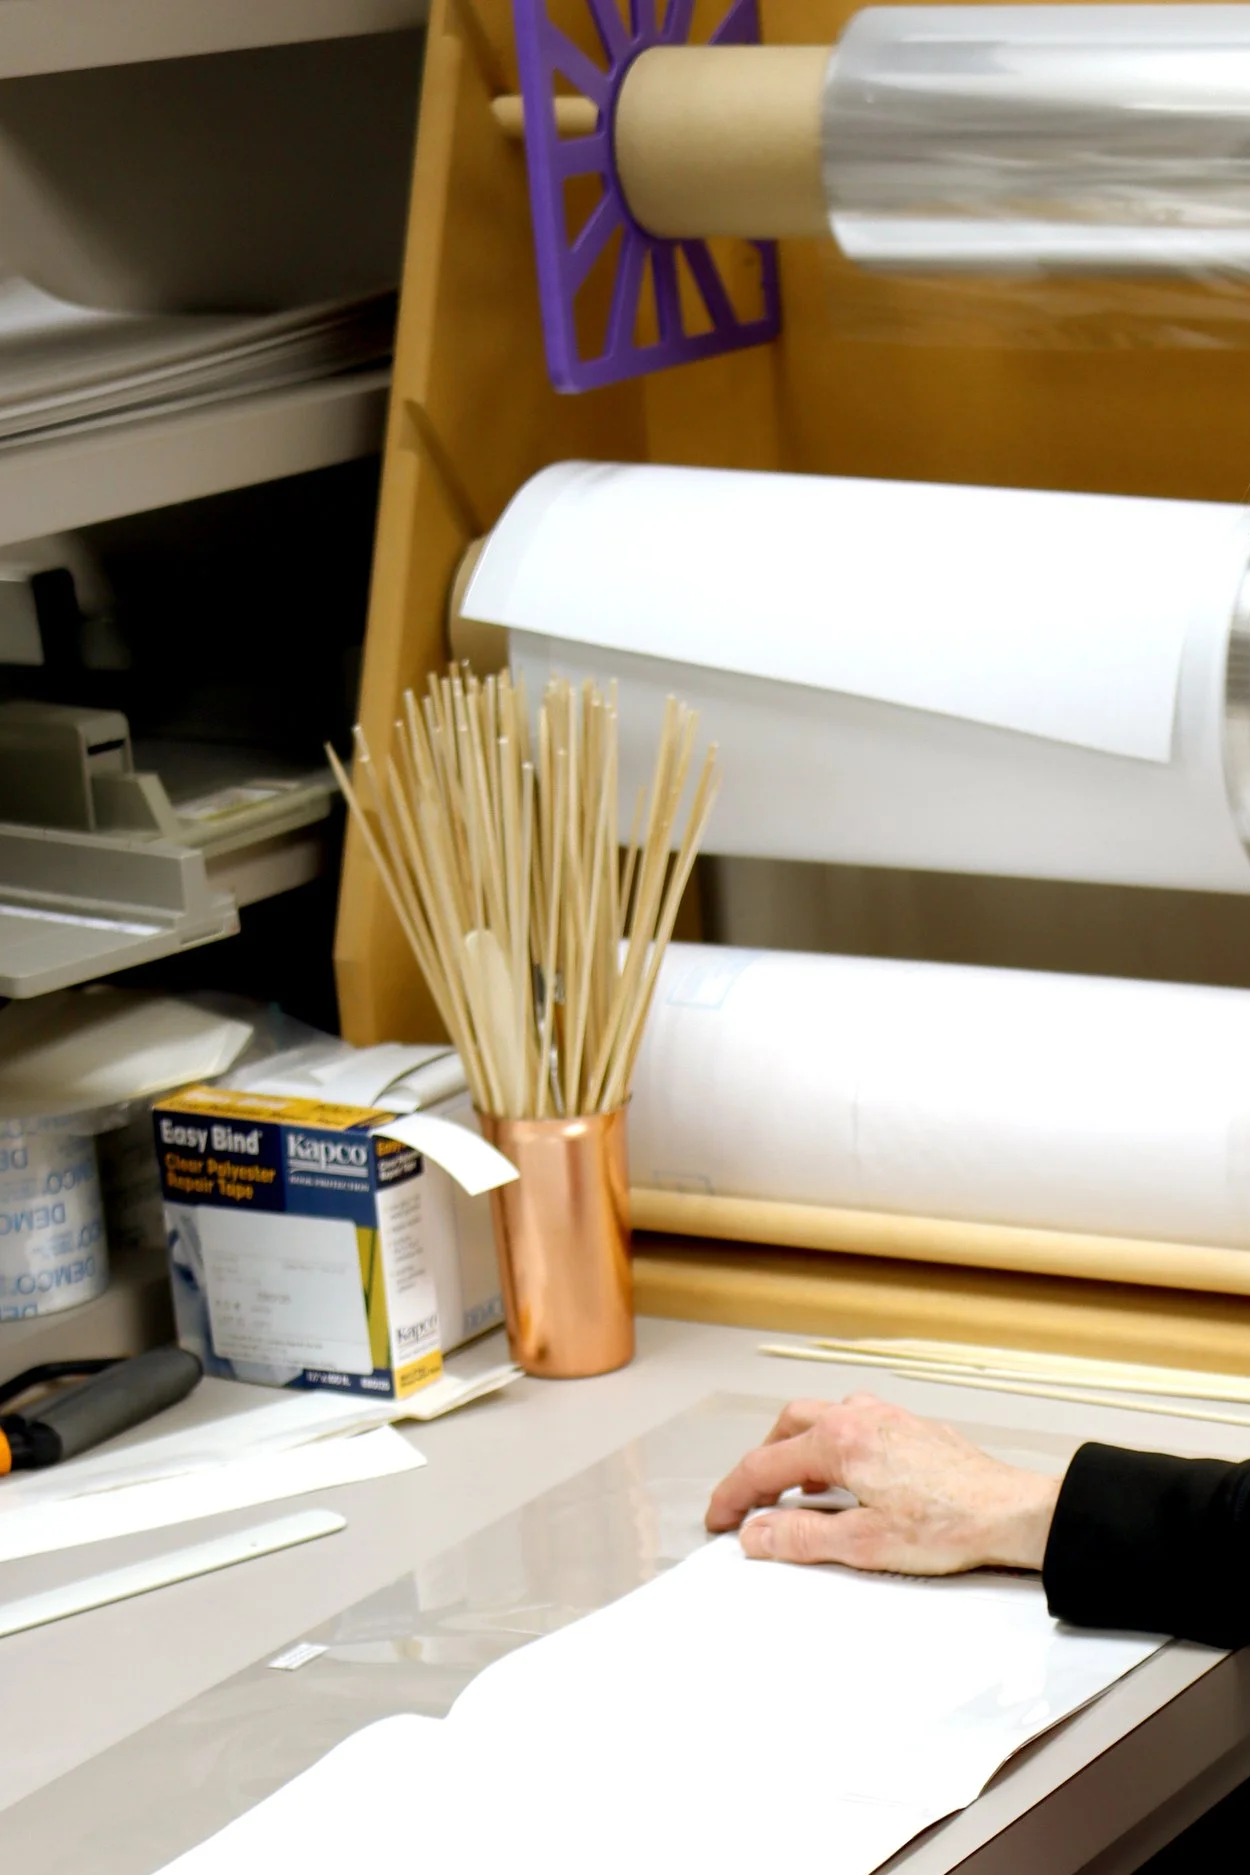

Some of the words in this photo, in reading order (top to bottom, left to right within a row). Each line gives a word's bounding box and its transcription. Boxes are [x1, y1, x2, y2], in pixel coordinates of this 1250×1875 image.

[159, 1118, 208, 1153] Easy
[210, 1123, 260, 1156] Bind
[287, 1133, 368, 1170] Kapco
[217, 1177, 255, 1202] Tape
